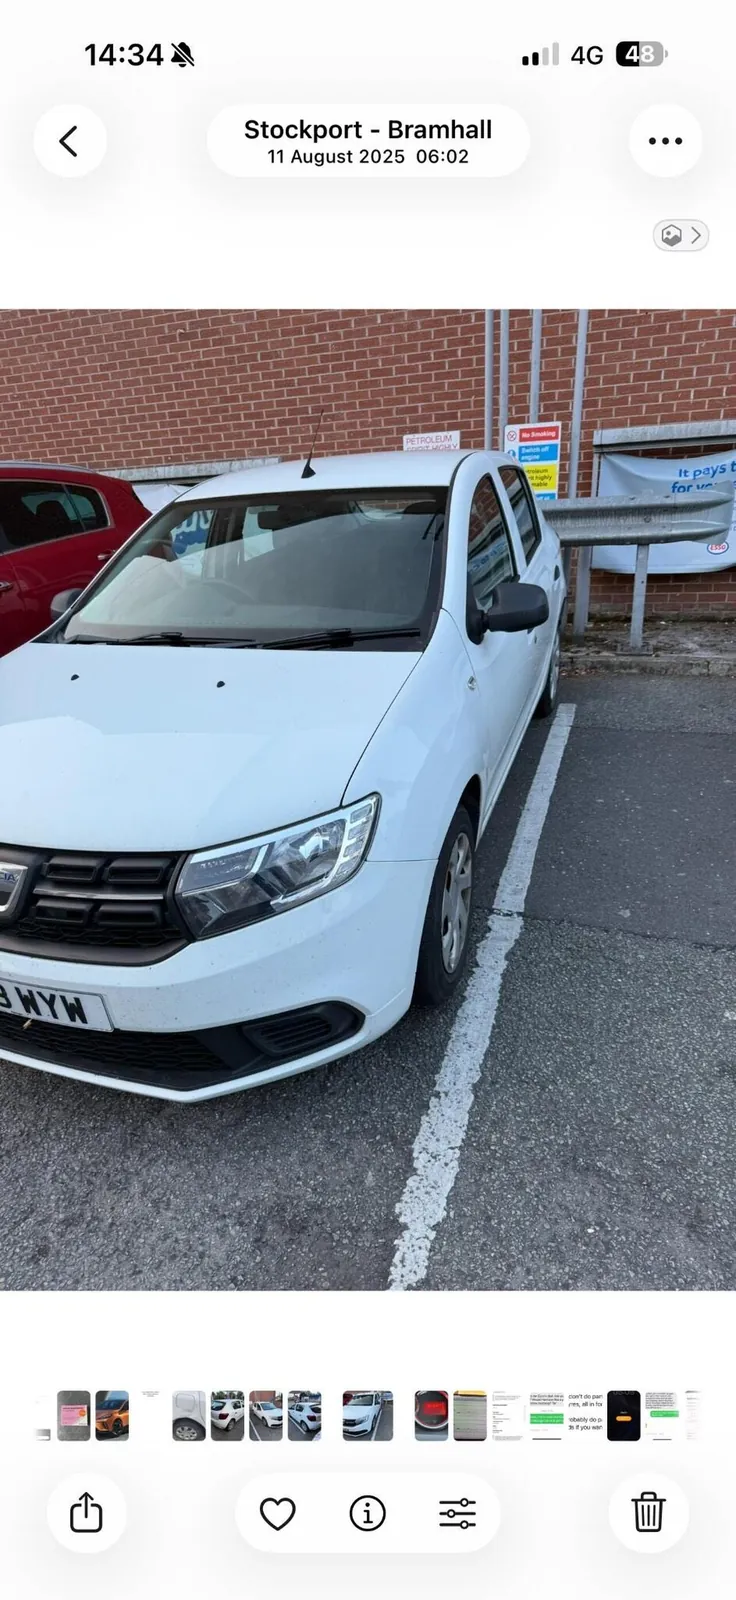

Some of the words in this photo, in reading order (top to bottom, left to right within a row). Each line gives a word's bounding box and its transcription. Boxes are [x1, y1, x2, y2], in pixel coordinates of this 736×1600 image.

[84, 43, 165, 66] 14:34
[571, 46, 603, 65] 4G
[625, 45, 654, 63] 48
[244, 119, 363, 144] Stockport
[388, 119, 492, 139] Bramhall
[267, 149, 284, 164] 11
[290, 149, 353, 167] August
[359, 148, 405, 164] 2025
[416, 148, 469, 164] 06:02
[406, 434, 452, 445] PETROLEUM
[521, 446, 540, 454] Switch
[541, 445, 550, 453] off
[678, 468, 690, 478] It
[693, 463, 727, 480] pays
[671, 481, 693, 493] for
[14, 987, 88, 1024] WYW
